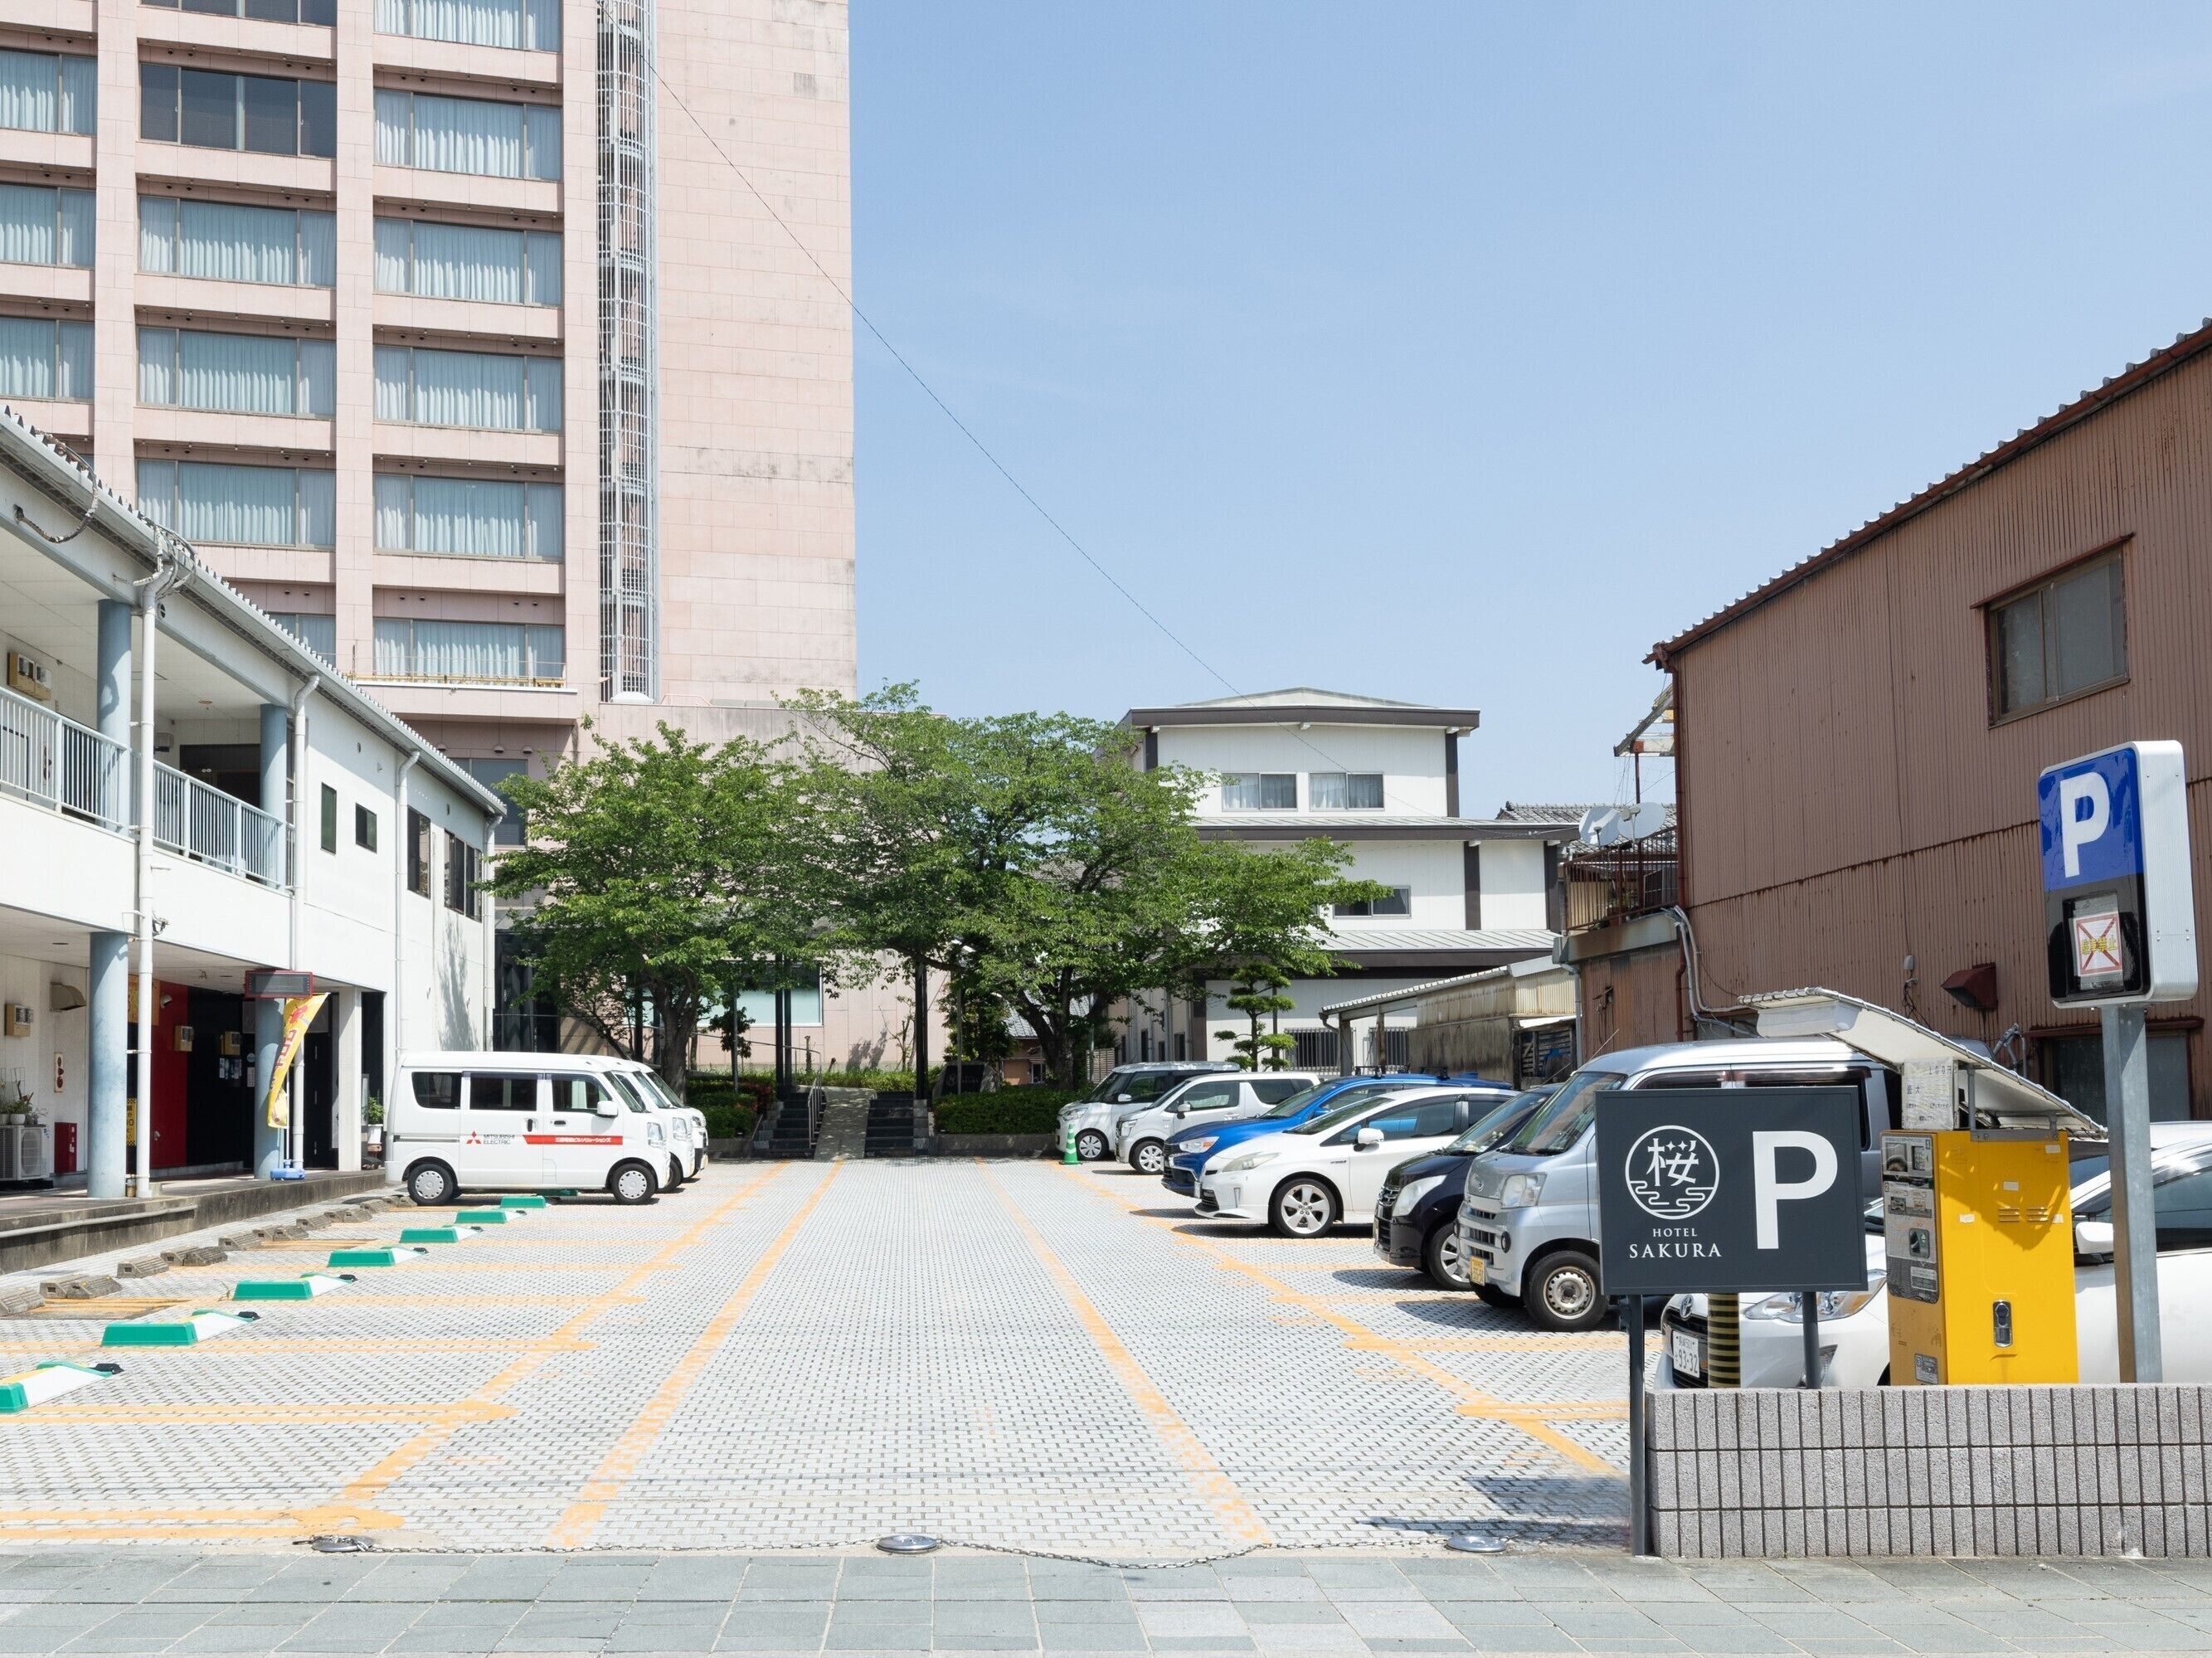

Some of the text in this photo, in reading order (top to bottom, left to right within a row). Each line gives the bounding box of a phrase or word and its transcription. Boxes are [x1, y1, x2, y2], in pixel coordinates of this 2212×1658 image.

[2060, 772, 2110, 878] P
[1646, 1138, 1699, 1187] 桜
[1753, 1130, 1838, 1249] P
[1629, 1242, 1722, 1258] SAKURA
[1653, 1228, 1698, 1237] HOTEL
